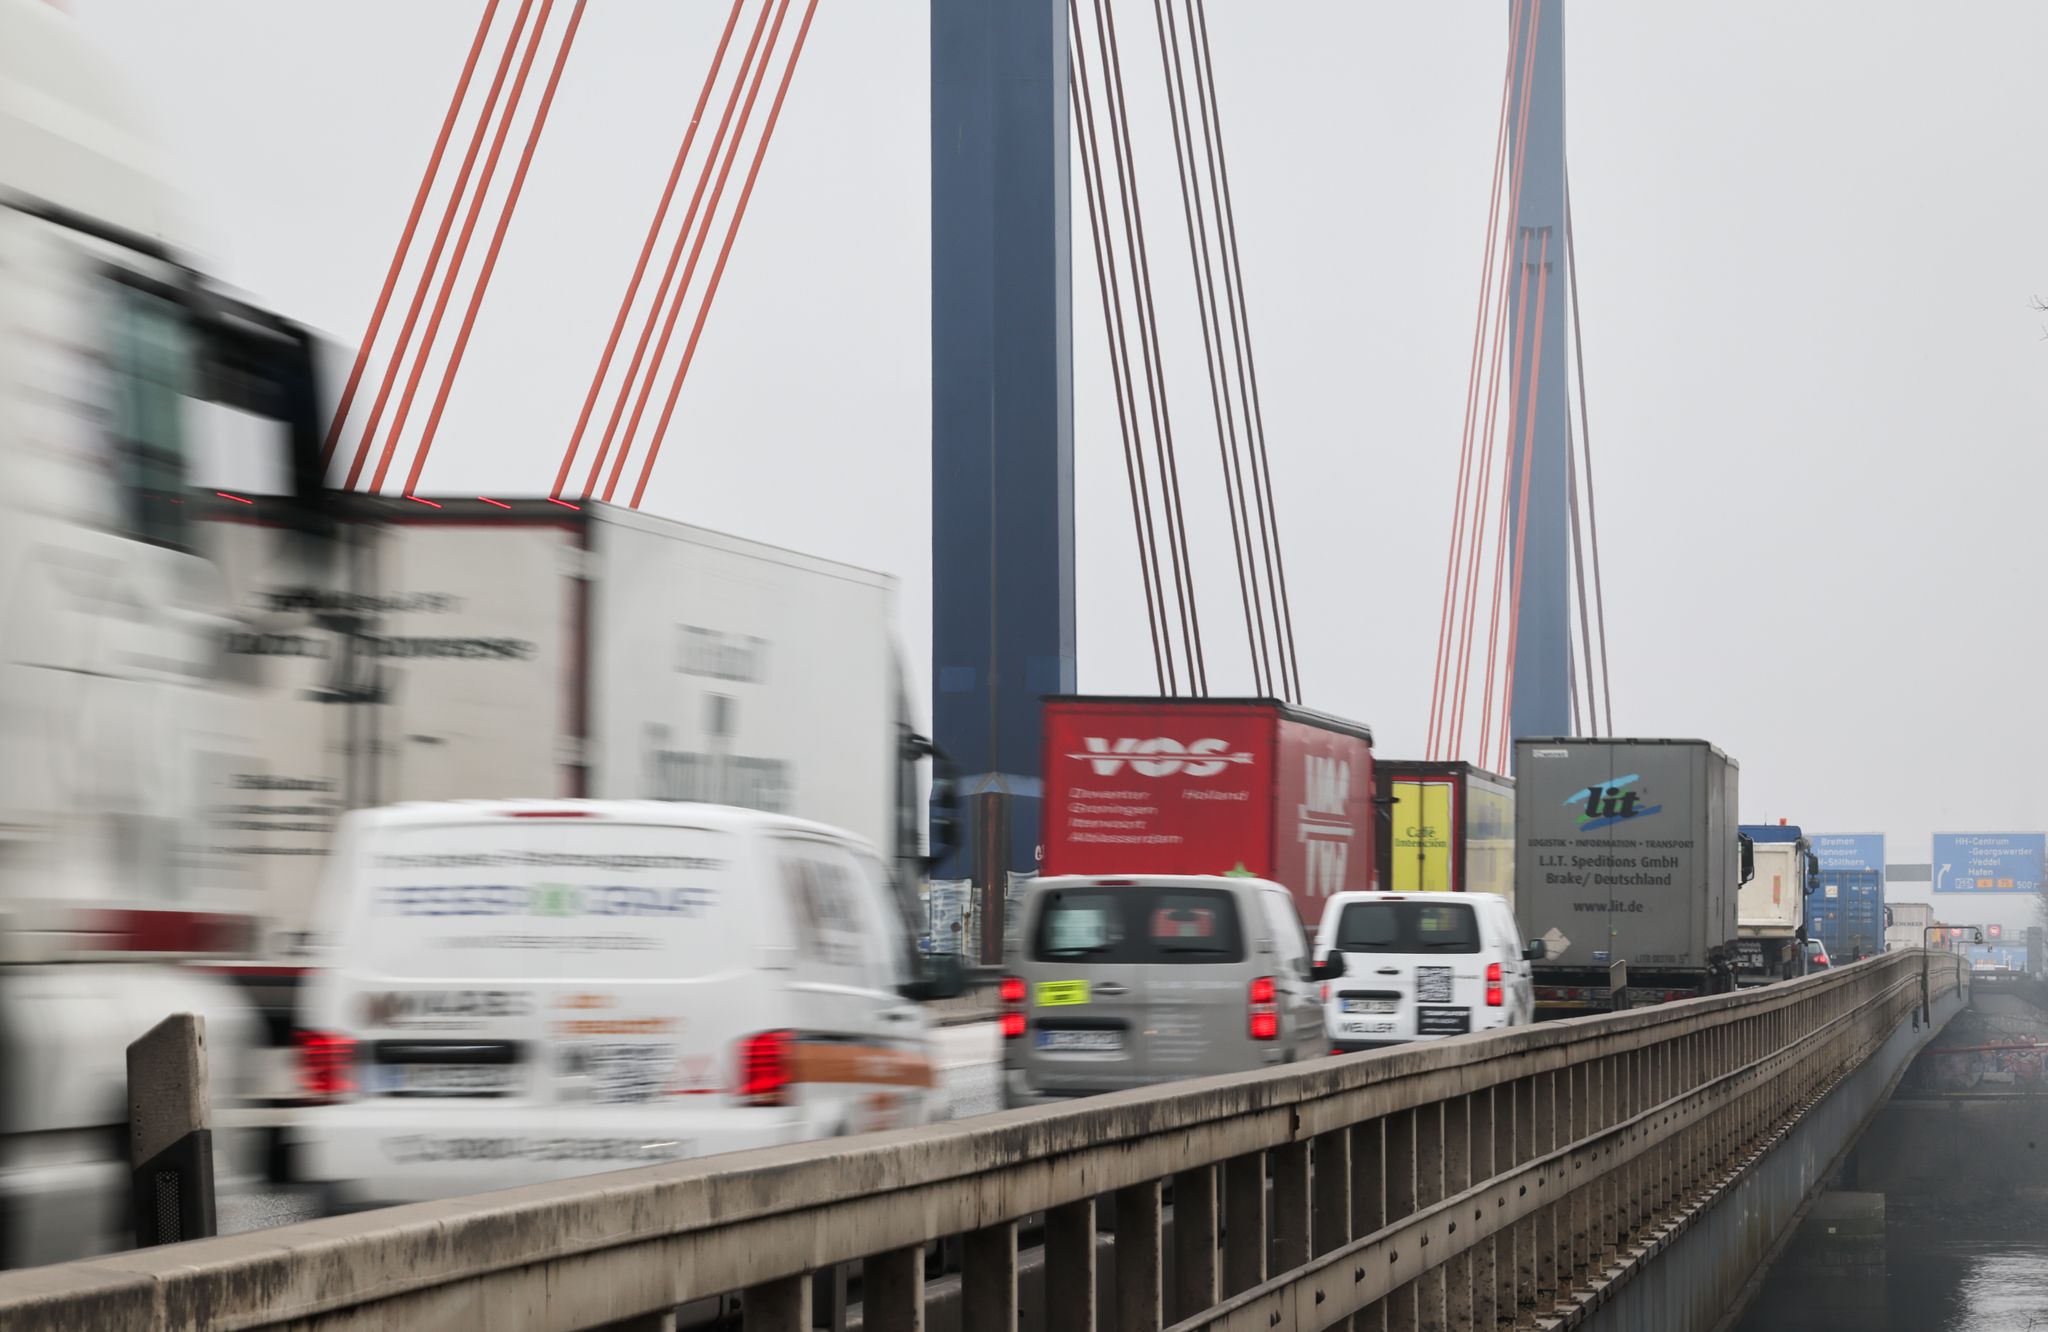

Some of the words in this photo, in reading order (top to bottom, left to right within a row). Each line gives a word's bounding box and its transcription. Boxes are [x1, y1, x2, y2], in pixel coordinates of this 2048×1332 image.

[1083, 737, 1230, 777] VOS
[1182, 788, 1249, 801] Holland
[1585, 787, 1640, 817] lit
[1528, 838, 1566, 847] LOGISTIK
[1575, 839, 1637, 848] INFORMATION
[1645, 840, 1694, 849] TRANSPORT
[1539, 855, 1568, 866] L.I.T.
[1571, 855, 1637, 869] Speditions
[1641, 856, 1679, 868] GmbH
[1968, 868, 1993, 876] Hafen
[1546, 872, 1590, 887] Brake/
[1594, 873, 1671, 886] Deutschland
[1573, 901, 1643, 912] www.lit.de
